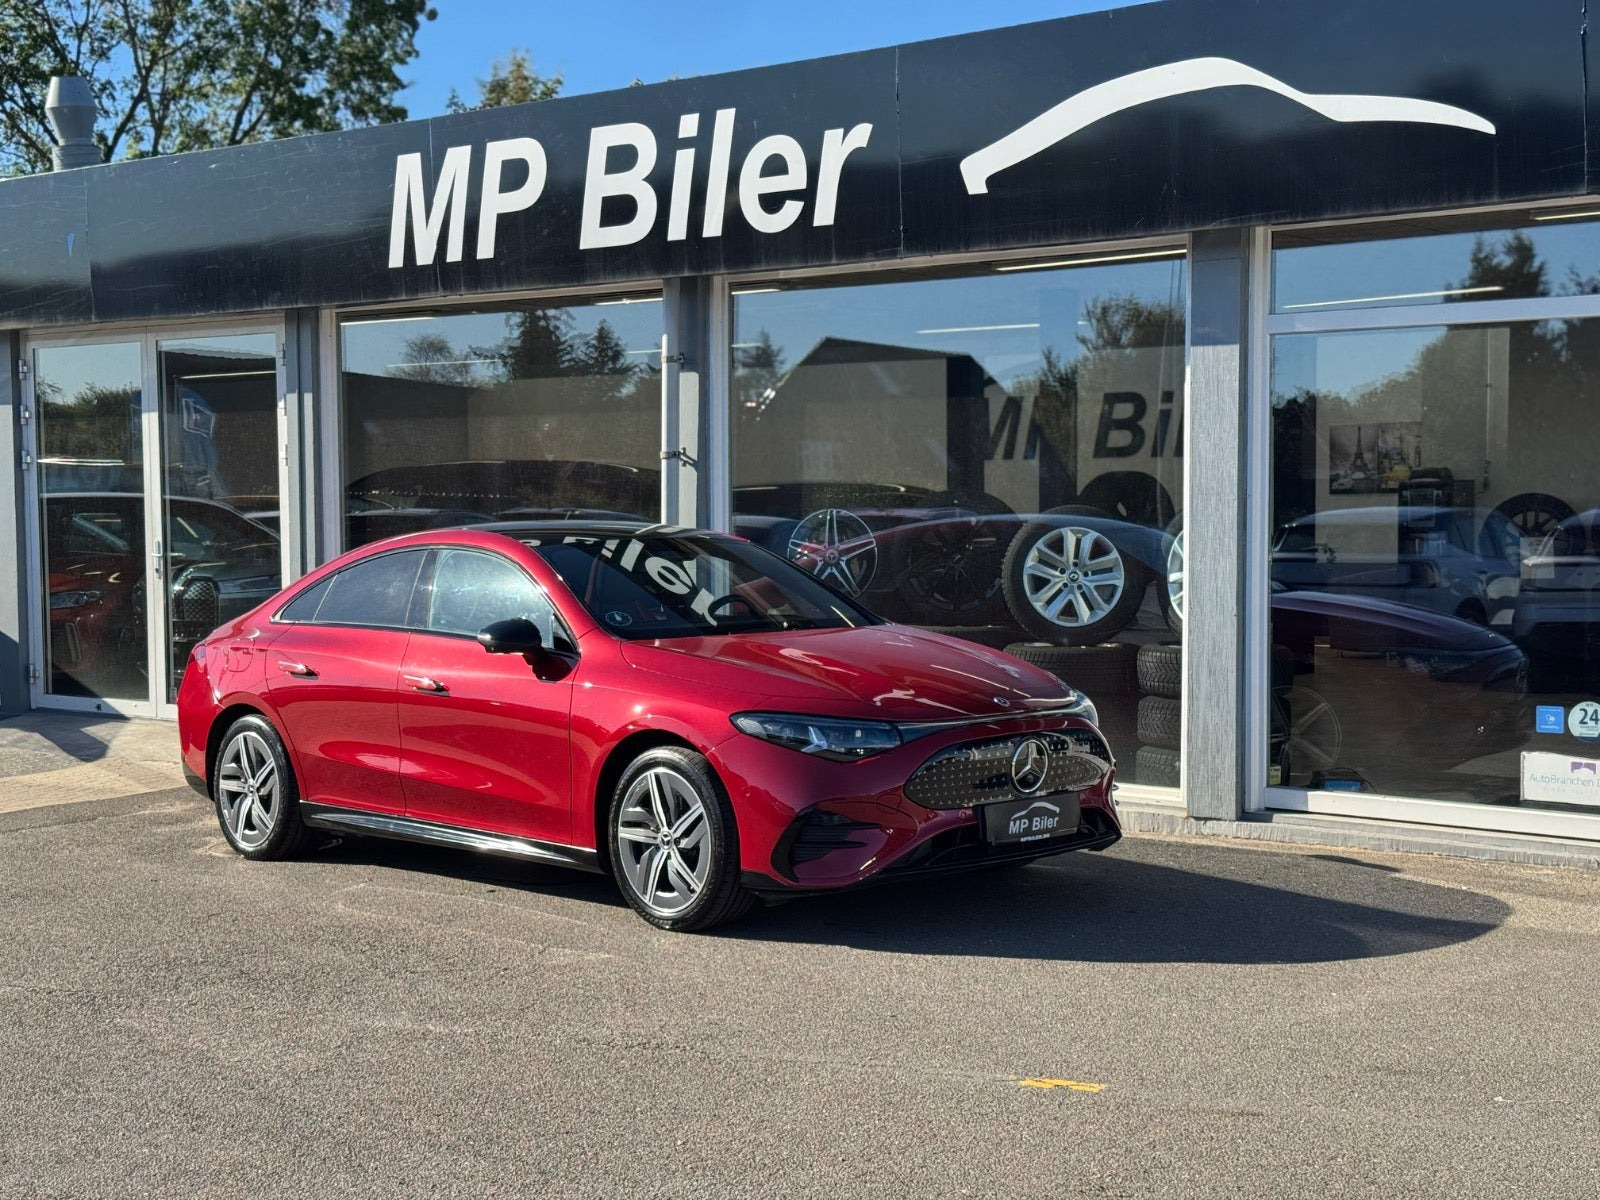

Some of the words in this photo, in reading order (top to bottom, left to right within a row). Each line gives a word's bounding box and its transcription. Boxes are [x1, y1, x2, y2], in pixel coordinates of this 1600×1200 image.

[387, 137, 547, 268] MP
[579, 107, 873, 250] Biler
[1578, 708, 1600, 726] 24
[1009, 819, 1029, 835] MP
[1032, 816, 1059, 831] Biler
